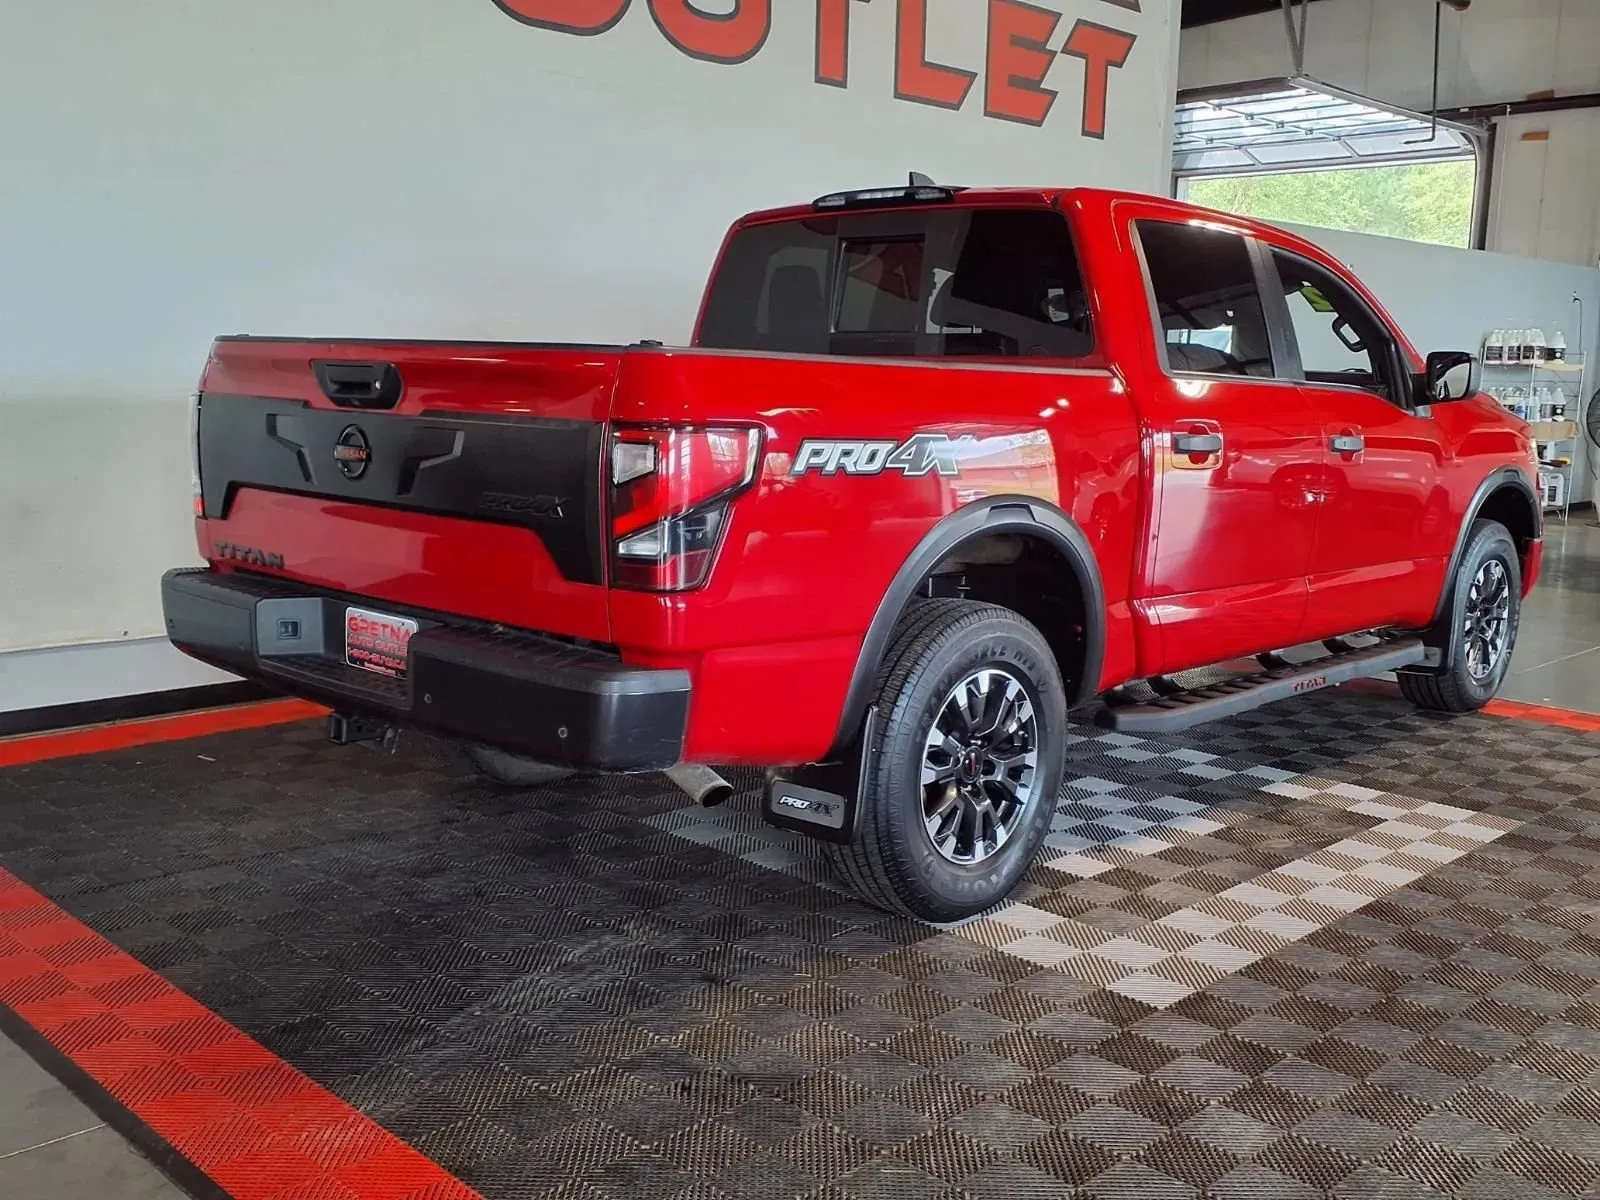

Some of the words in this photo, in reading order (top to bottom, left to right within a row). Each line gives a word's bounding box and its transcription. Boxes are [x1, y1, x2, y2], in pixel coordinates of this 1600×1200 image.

[491, 0, 1138, 139] TLET
[214, 541, 284, 569] TITAN
[348, 616, 410, 643] GRETNA
[375, 640, 408, 657] OUTLE
[1292, 675, 1327, 692] TITAN
